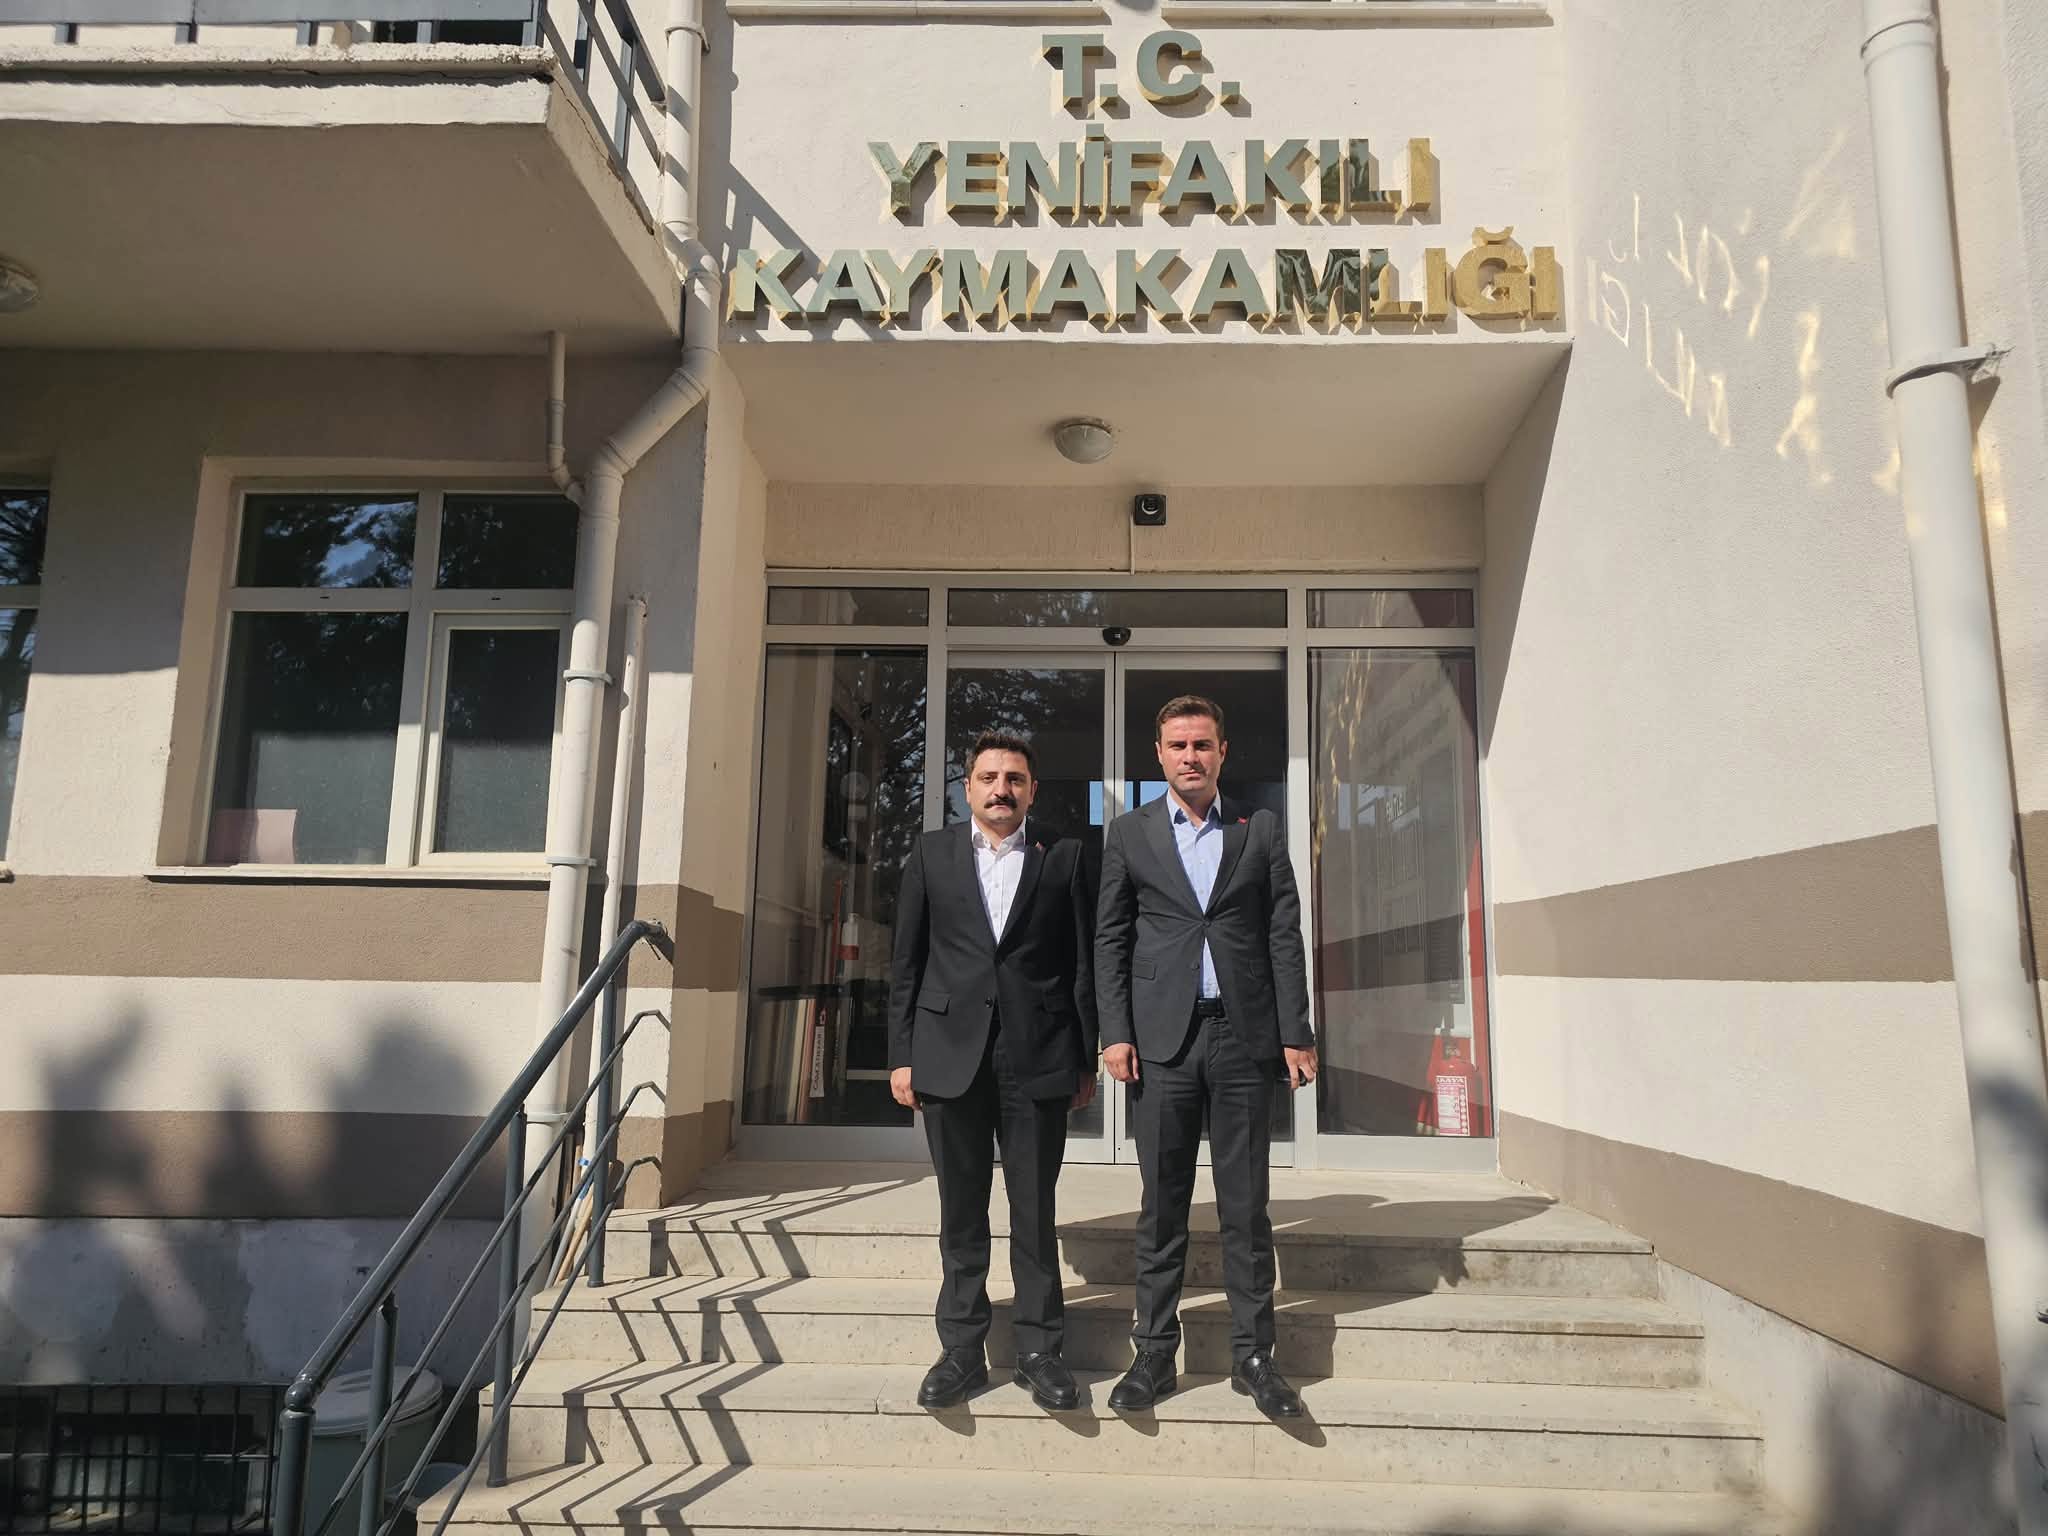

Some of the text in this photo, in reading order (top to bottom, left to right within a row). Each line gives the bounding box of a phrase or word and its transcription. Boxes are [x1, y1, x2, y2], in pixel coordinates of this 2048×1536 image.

[1042, 30, 1240, 104] T.C.
[868, 123, 1431, 211] YENİFAKILI
[734, 226, 1557, 320] KAYMAKAMLIĞI
